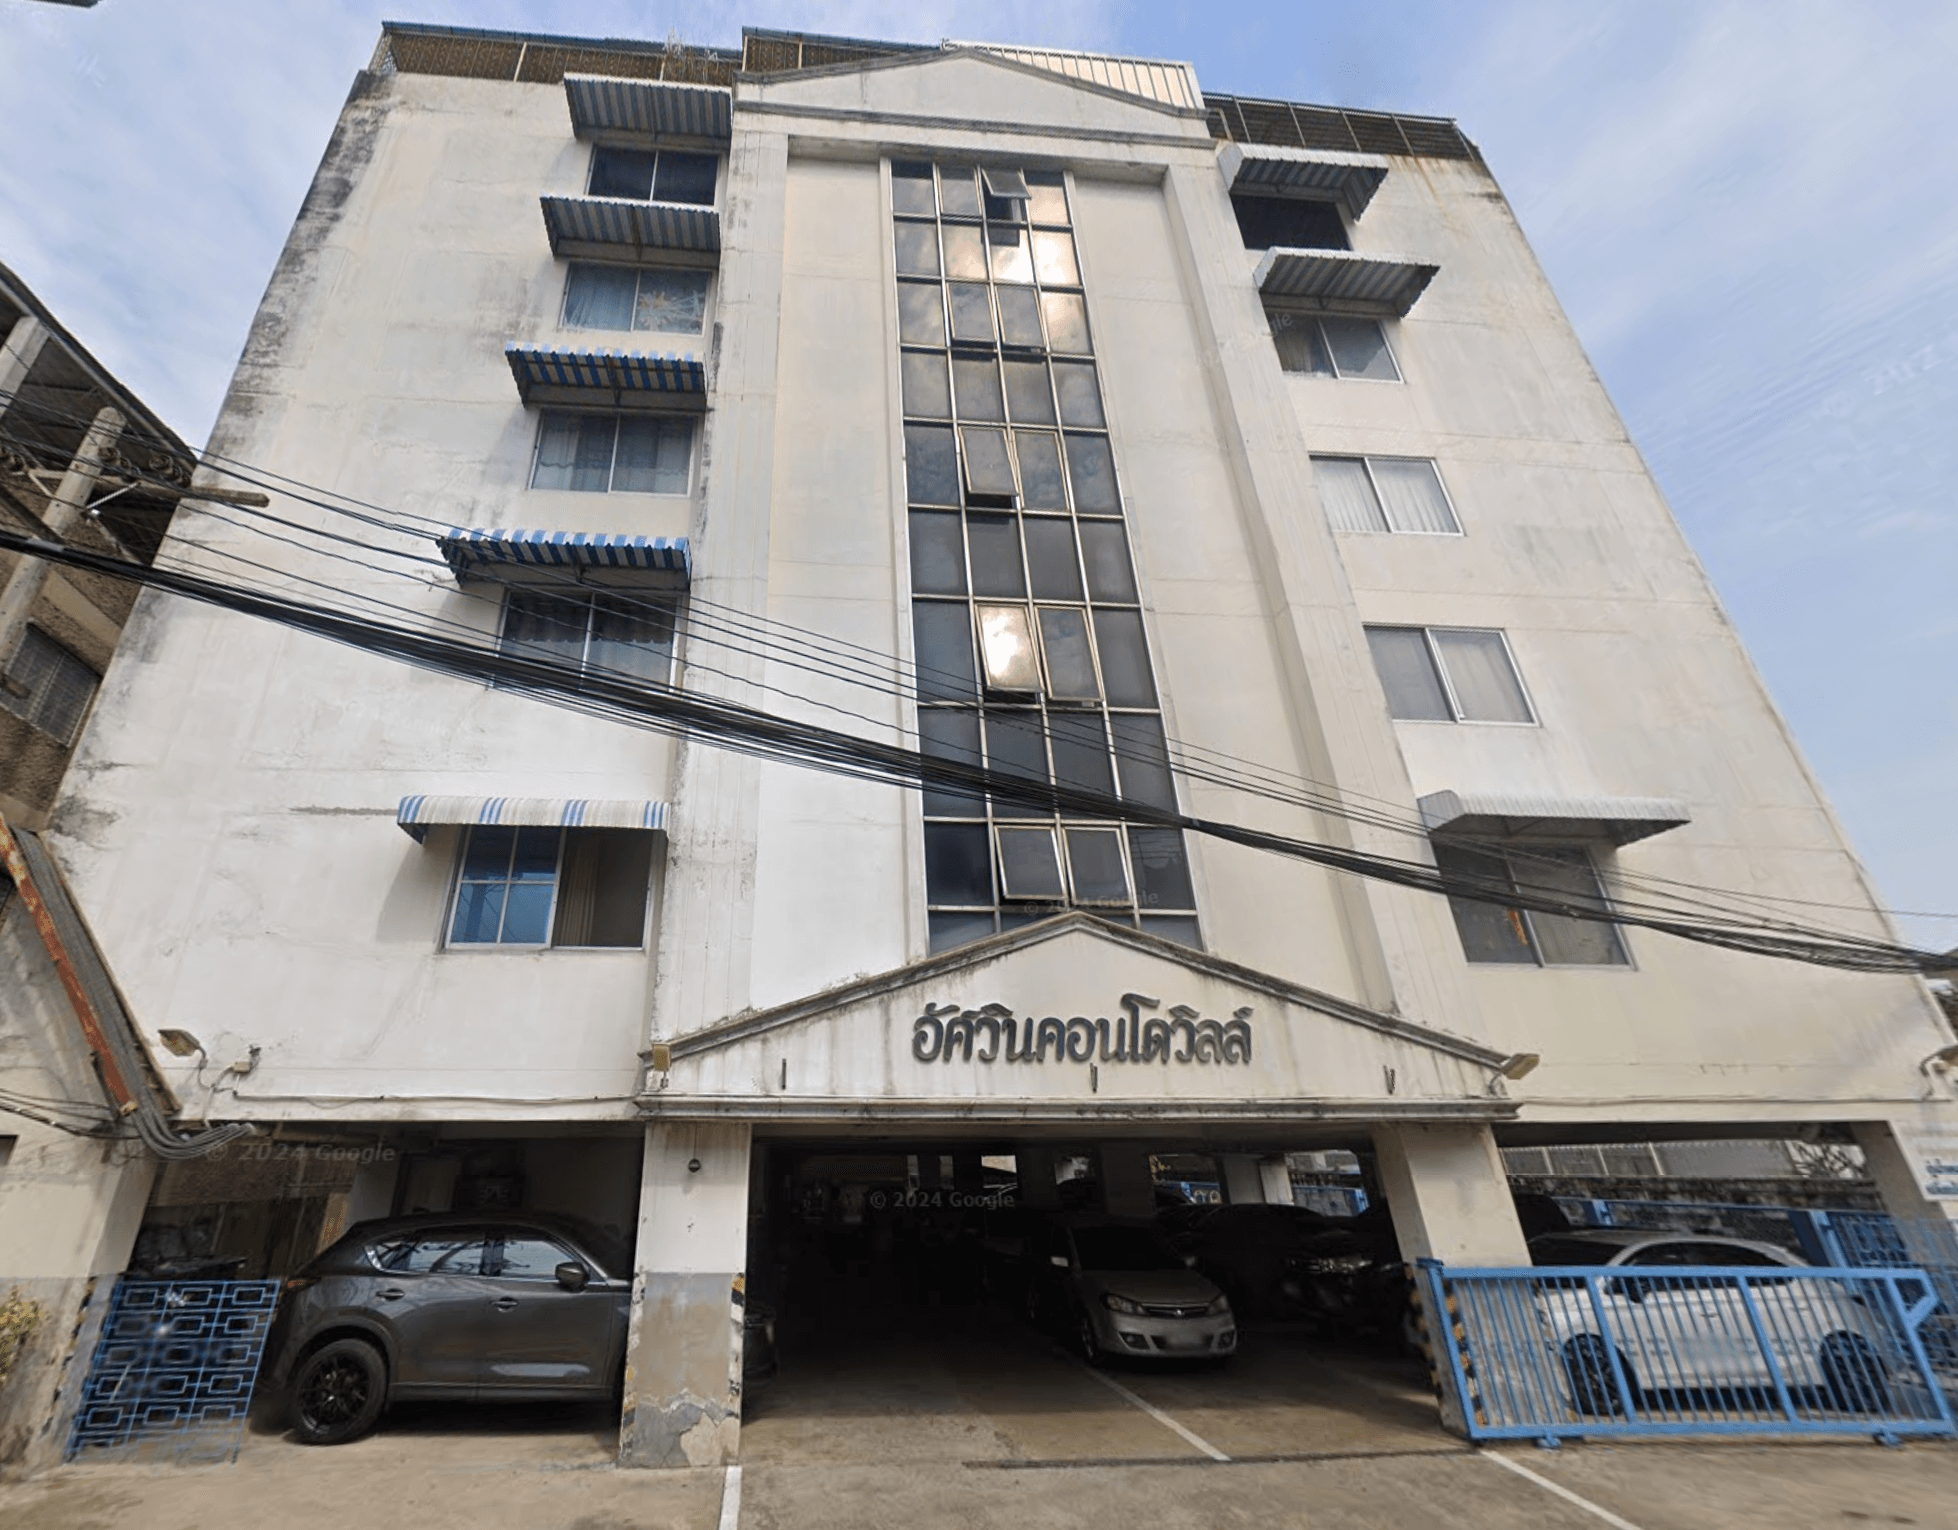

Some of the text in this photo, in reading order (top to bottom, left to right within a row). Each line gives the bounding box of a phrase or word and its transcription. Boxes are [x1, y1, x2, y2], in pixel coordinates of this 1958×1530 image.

[912, 992, 1254, 1064] อัศวินคอนโดวิลล์
